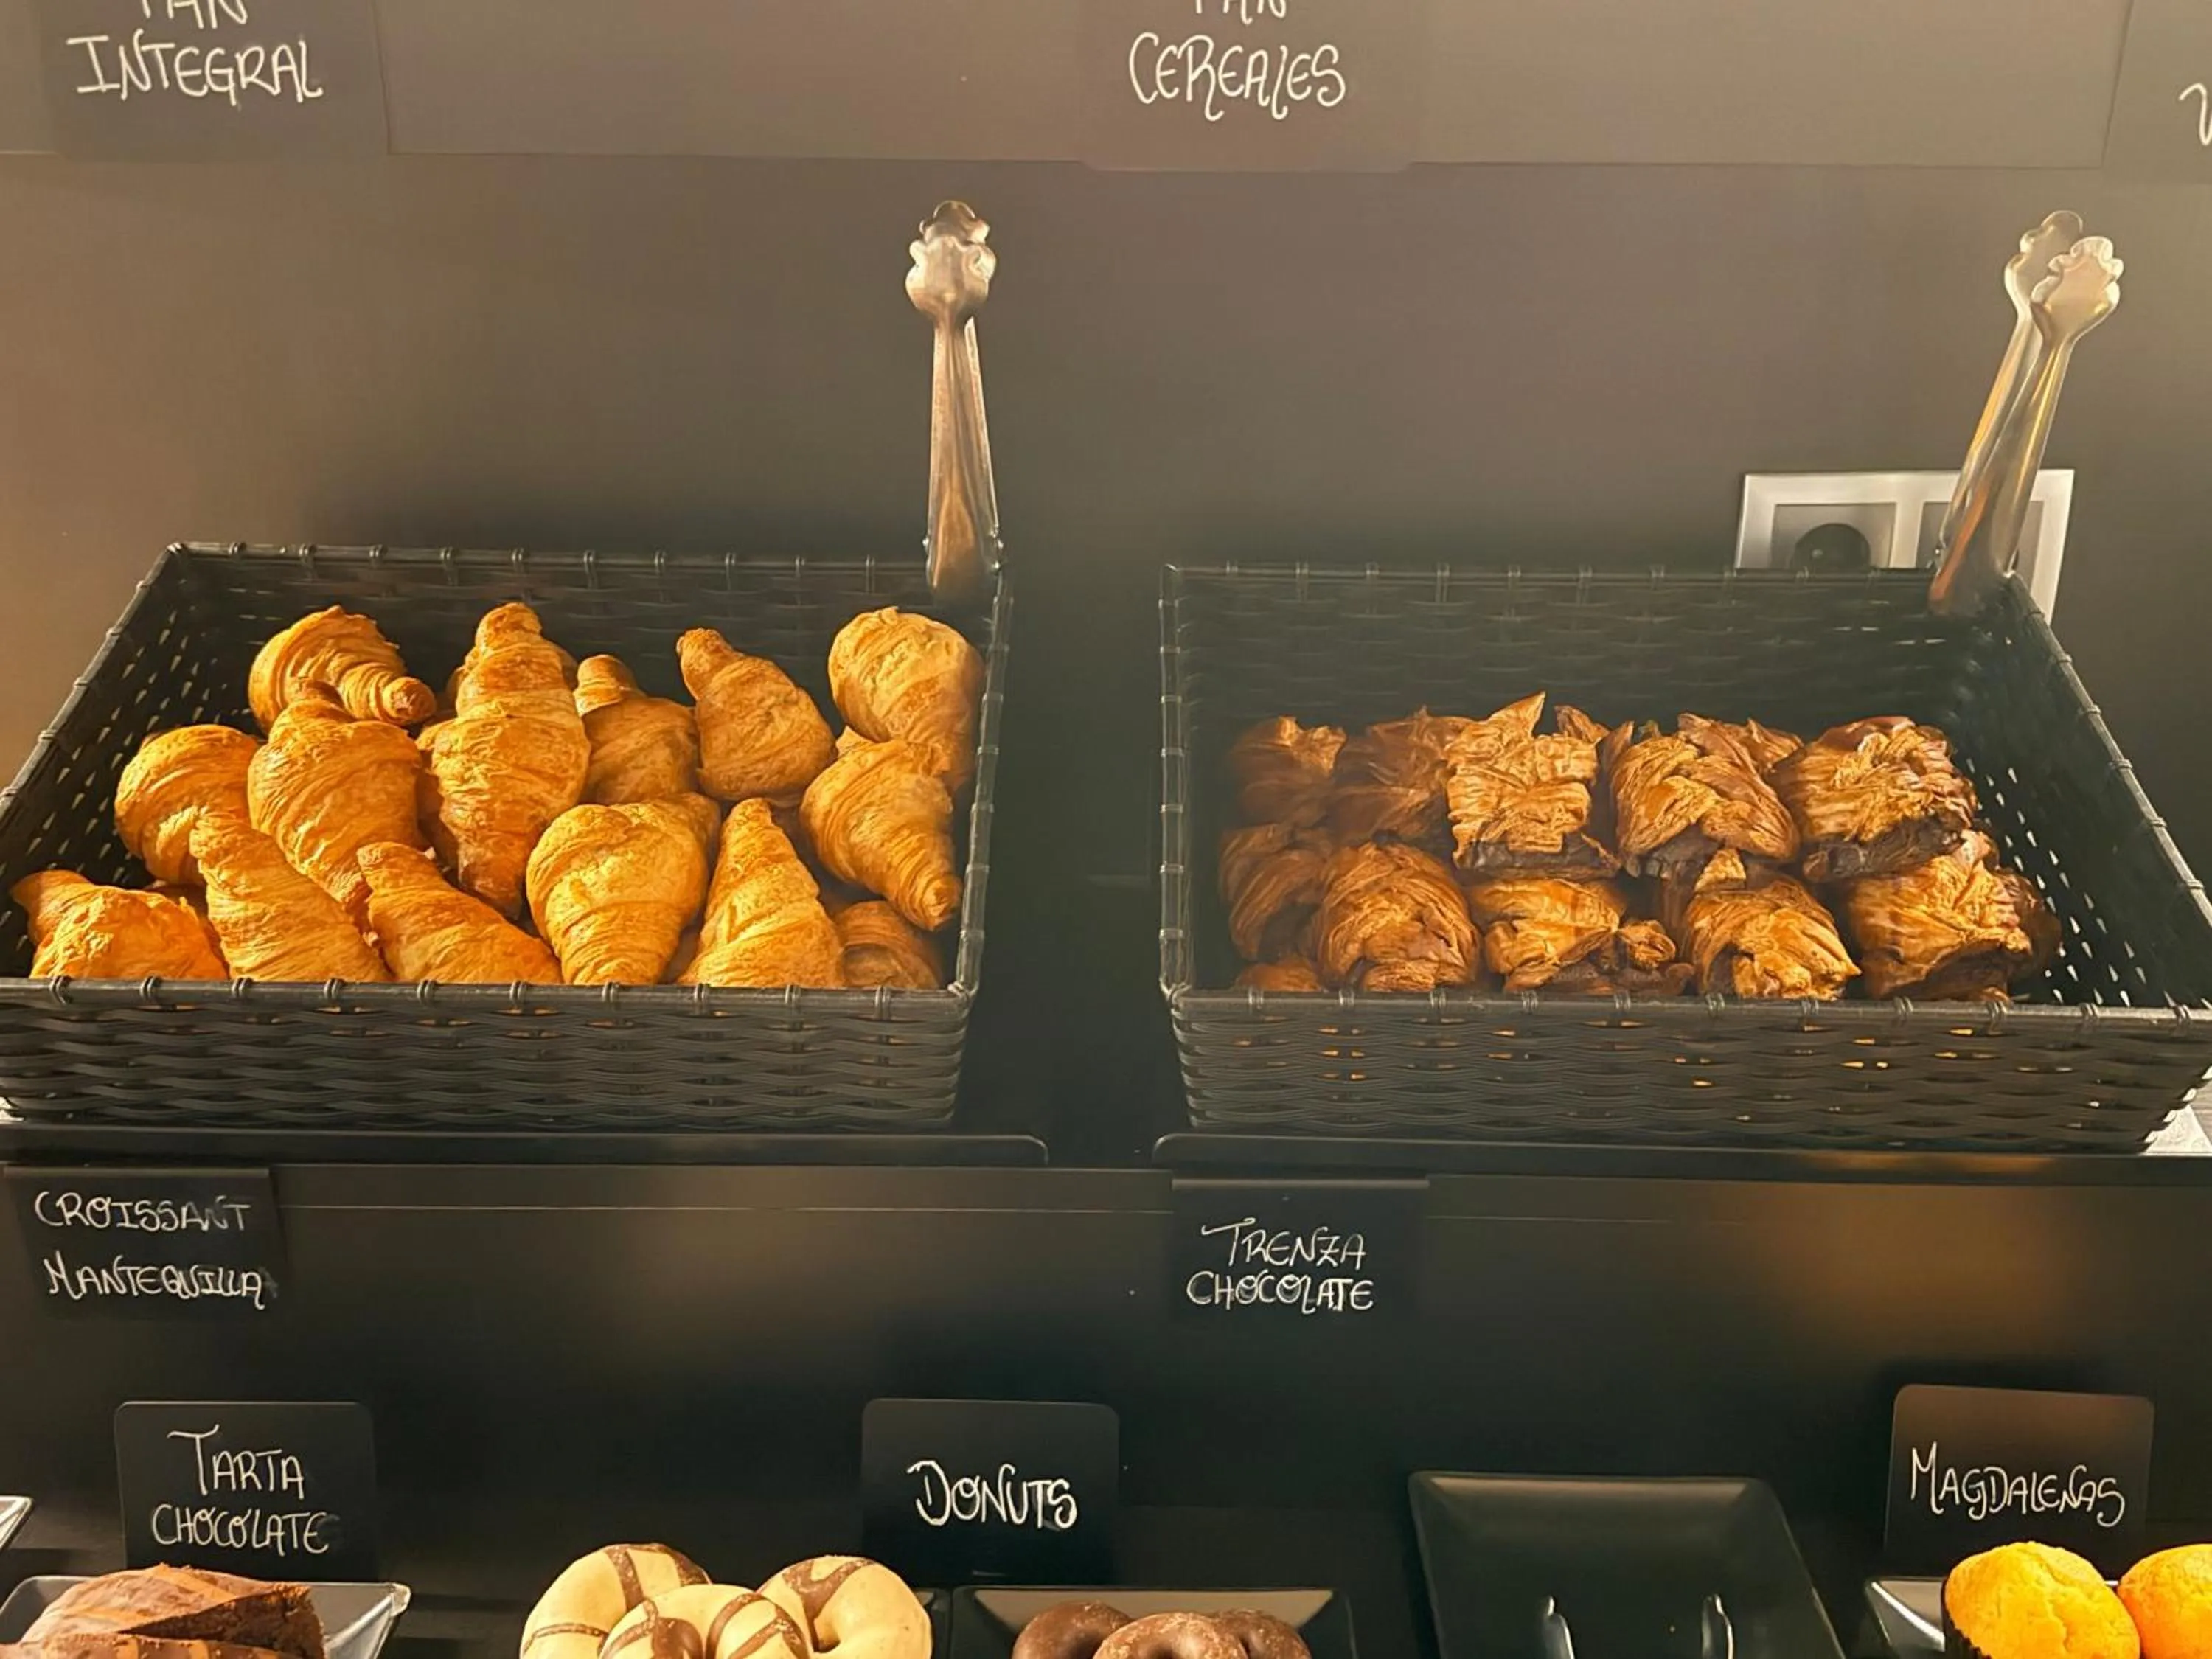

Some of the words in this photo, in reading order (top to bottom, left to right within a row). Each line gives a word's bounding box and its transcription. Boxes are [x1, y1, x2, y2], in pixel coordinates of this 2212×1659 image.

[66, 28, 324, 107] INTEGRAL
[1128, 32, 1346, 122] CEREALES
[34, 1190, 251, 1232] CROISSANT
[1200, 1217, 1367, 1270] TRENZA
[42, 1249, 266, 1310] MANTEQUILLA
[1186, 1269, 1374, 1315] CHOCOLATE
[166, 1423, 305, 1500] TARTA
[905, 1459, 1078, 1529] DONUTS
[1910, 1441, 2126, 1528] MAGDALENAS
[151, 1503, 330, 1557] CHOCOLATE
